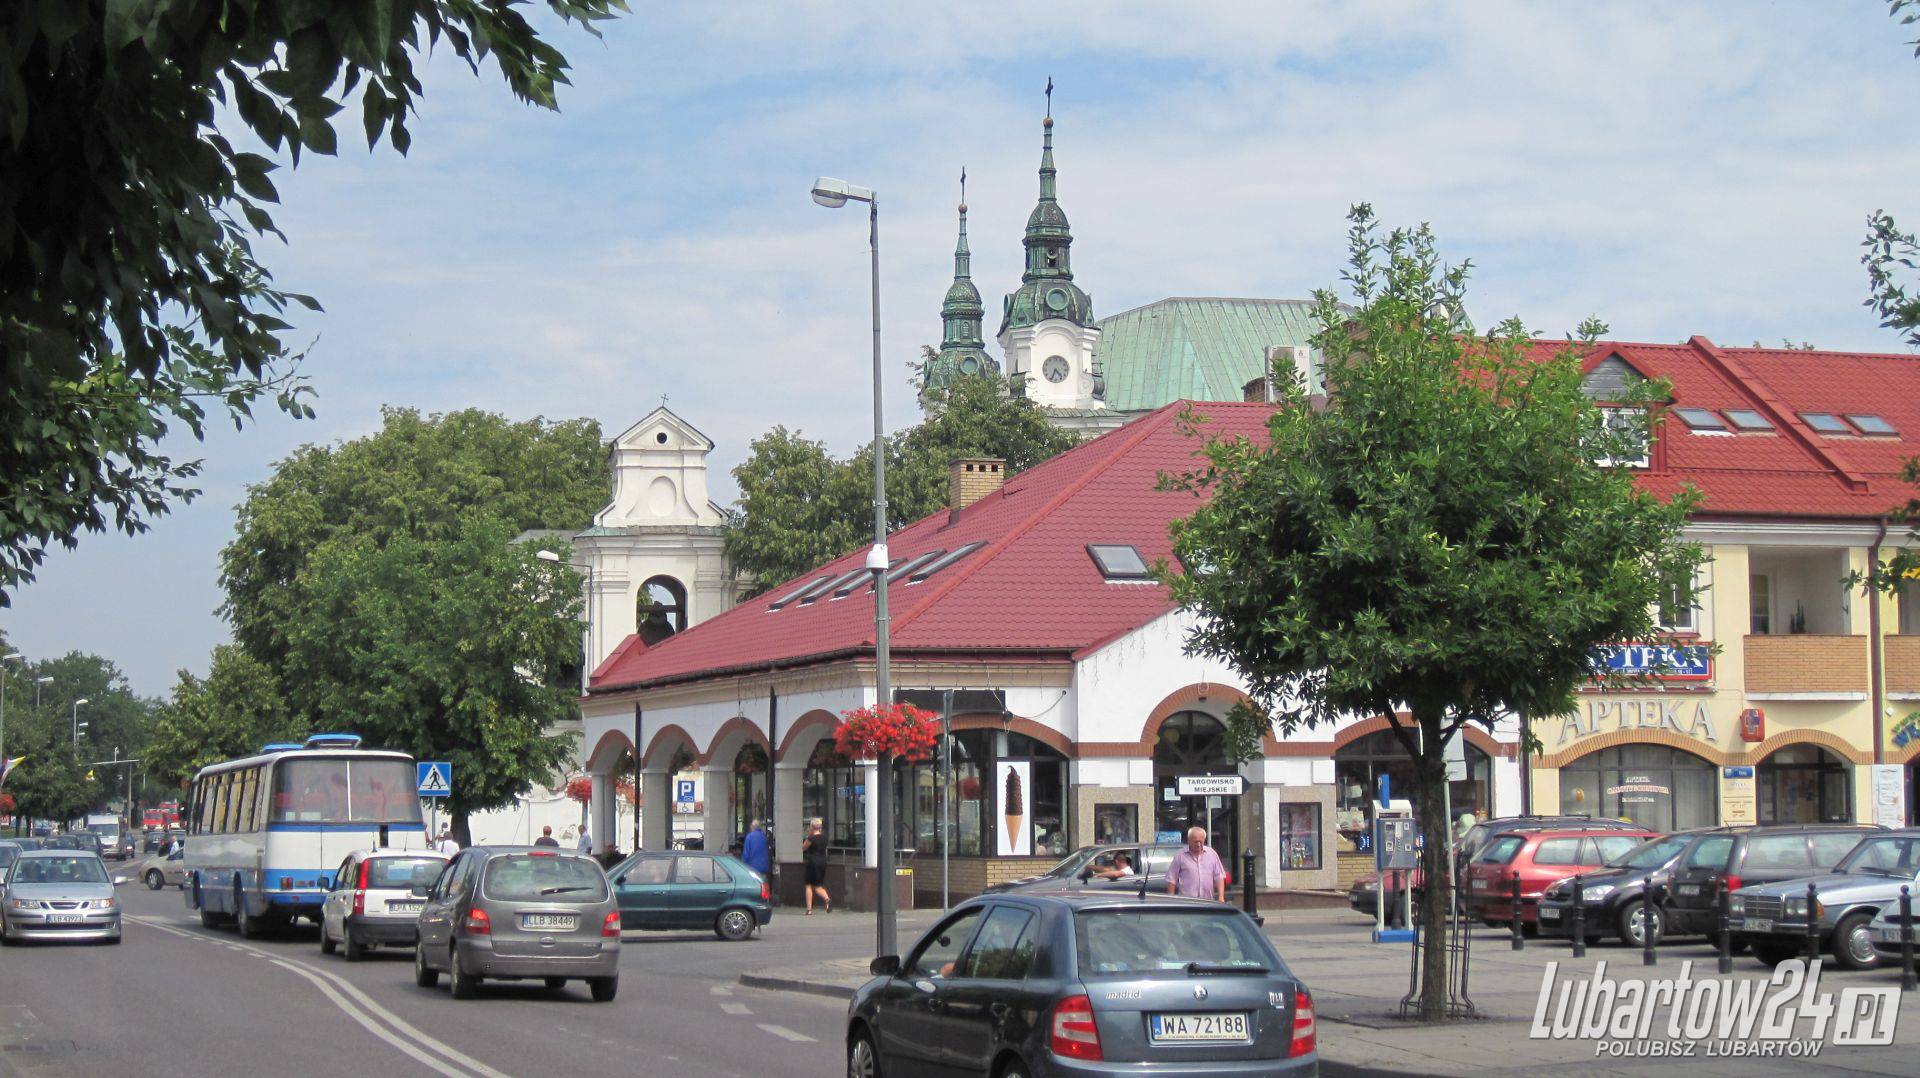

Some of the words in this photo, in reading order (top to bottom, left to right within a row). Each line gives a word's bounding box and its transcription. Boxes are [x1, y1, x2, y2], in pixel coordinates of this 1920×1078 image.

[1558, 699, 1717, 744] APTEKA
[682, 782, 691, 796] P
[528, 915, 545, 925] LLB
[547, 916, 574, 926] 38449
[1164, 1017, 1188, 1034] WA
[1193, 1016, 1243, 1034] 72188
